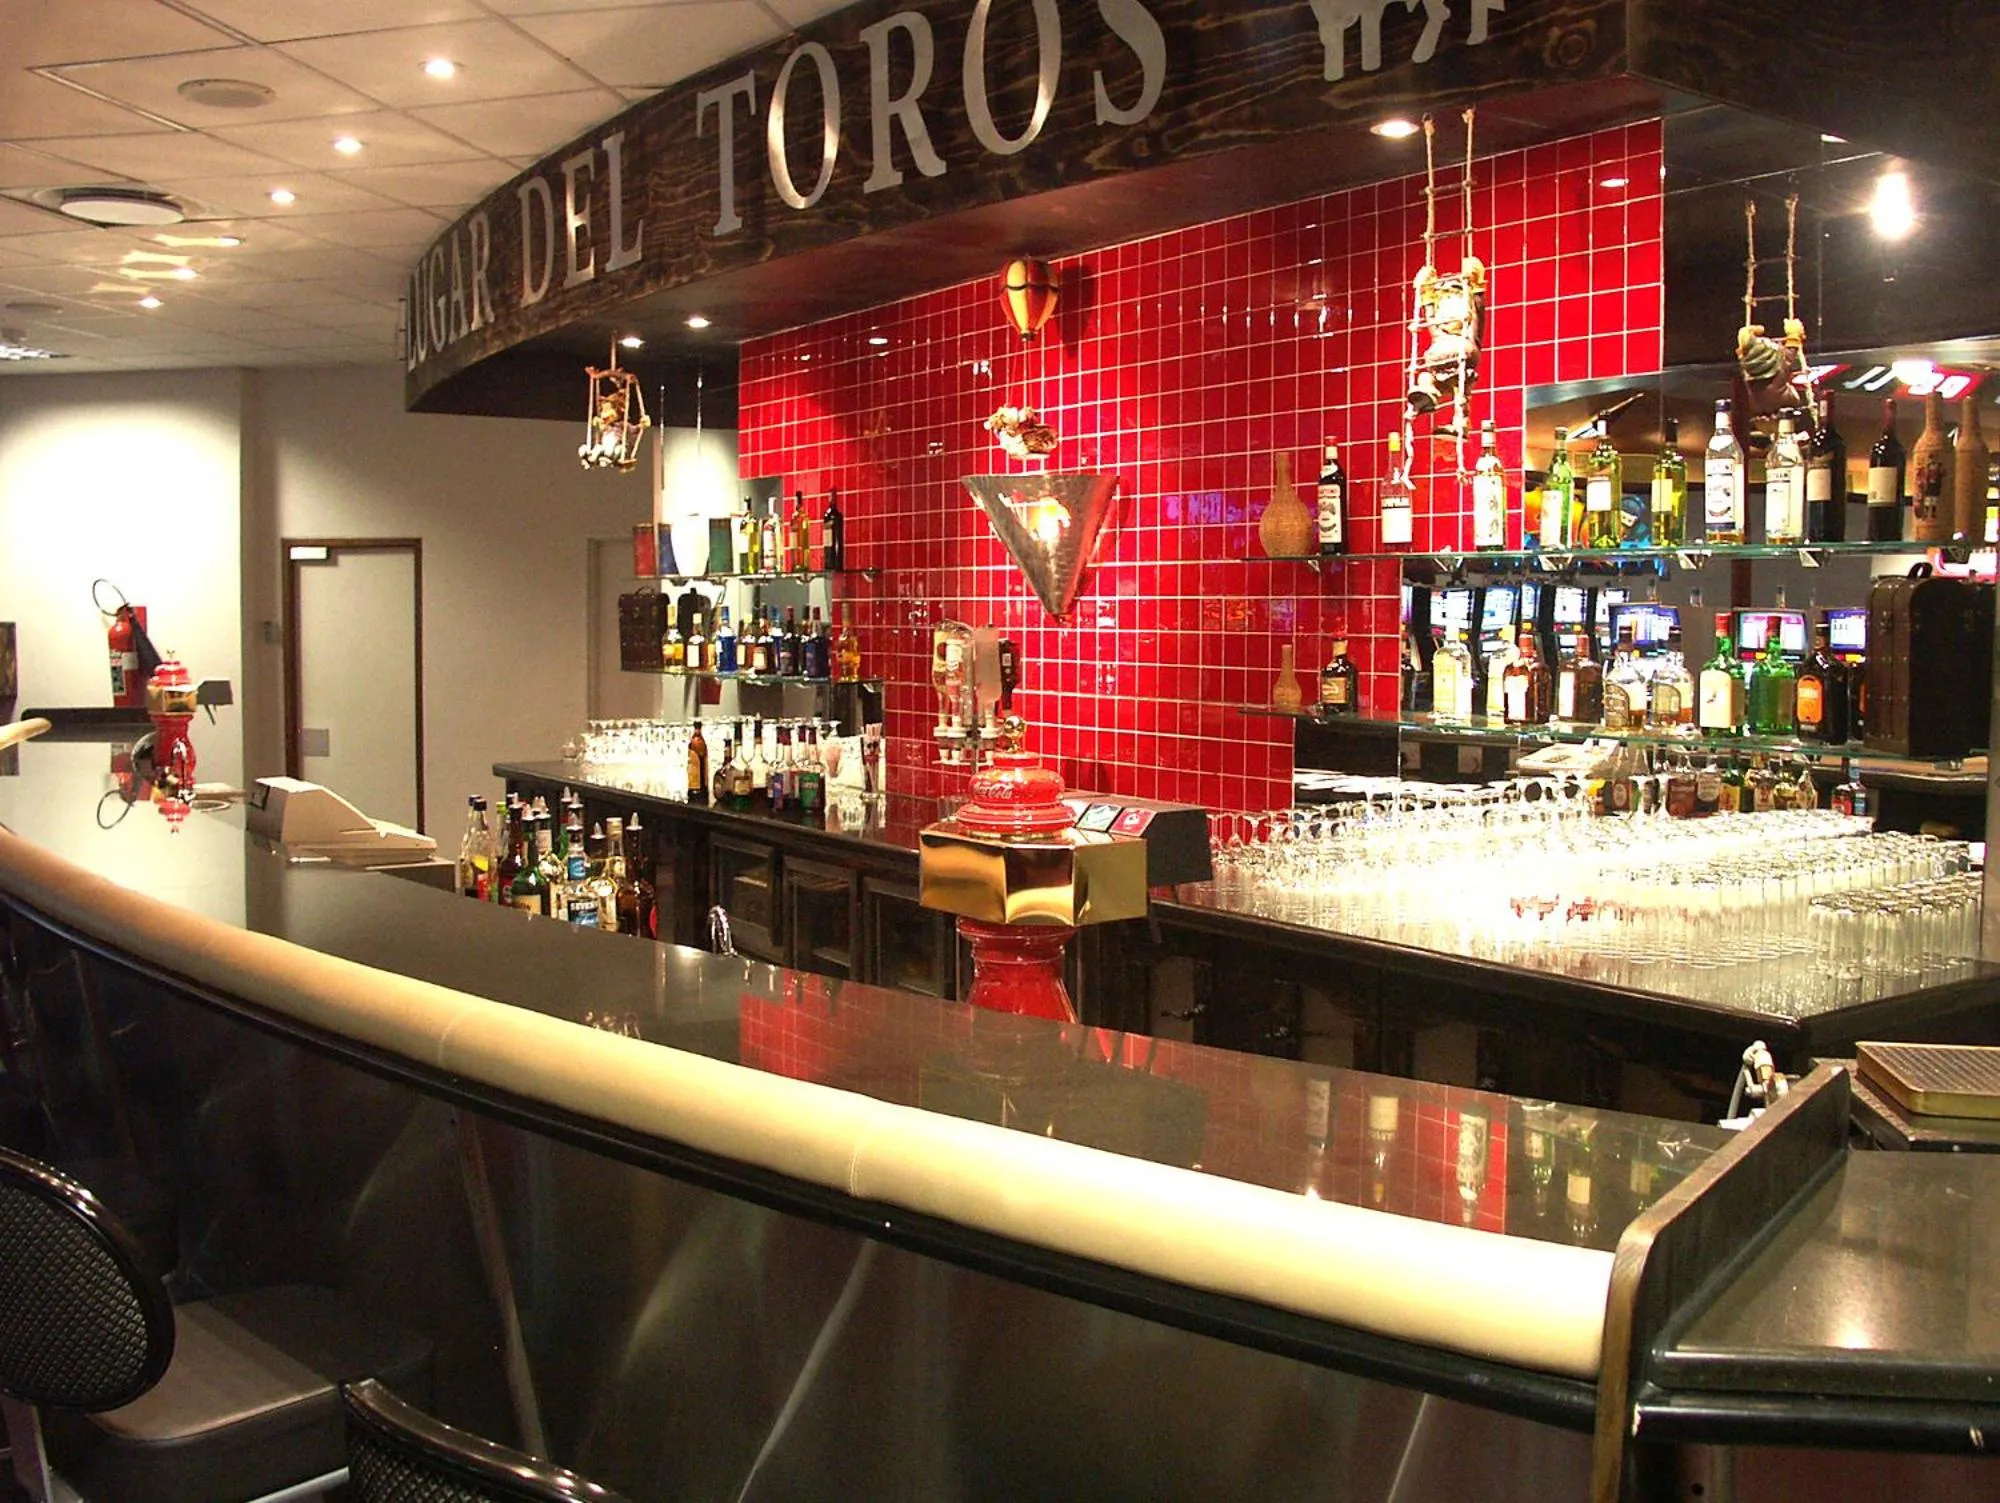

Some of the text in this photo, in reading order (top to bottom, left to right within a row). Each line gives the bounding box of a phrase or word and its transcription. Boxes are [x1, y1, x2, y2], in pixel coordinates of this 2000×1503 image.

[407, 0, 1166, 372] LUGAR DEL TOROS
